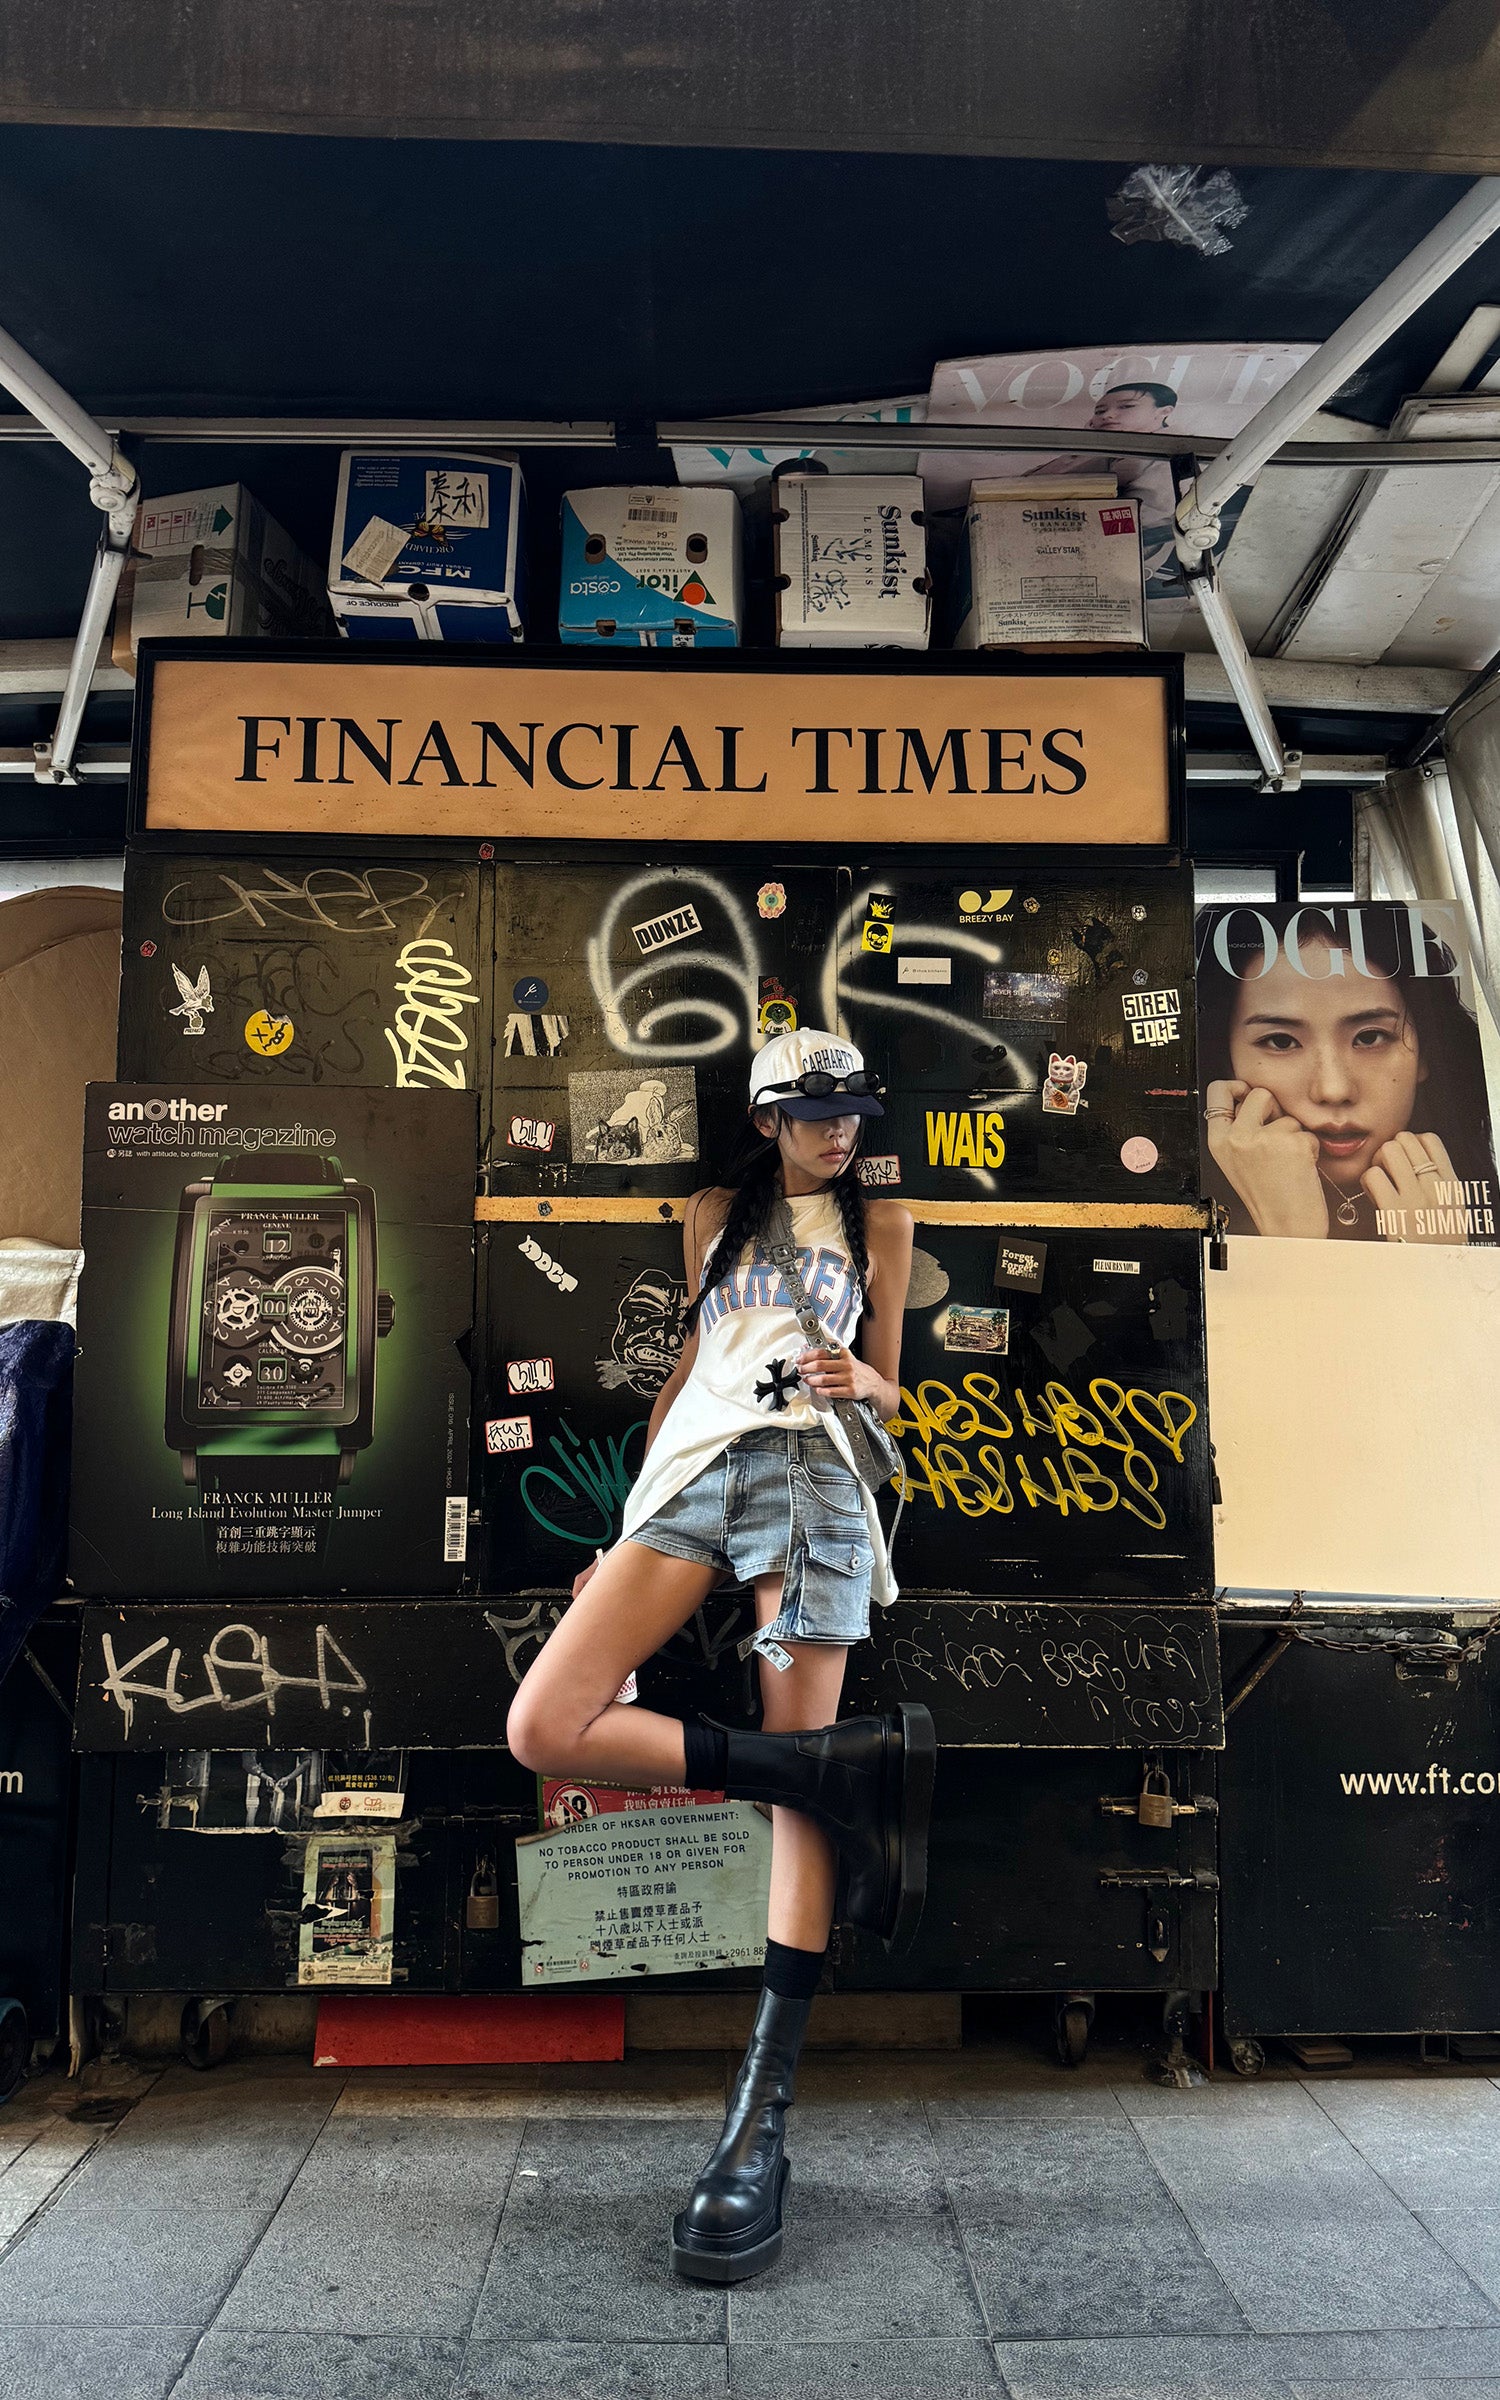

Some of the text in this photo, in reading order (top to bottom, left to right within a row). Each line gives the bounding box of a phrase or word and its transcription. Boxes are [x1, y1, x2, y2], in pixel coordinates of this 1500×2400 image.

[1022, 507, 1088, 524] Sunkist
[1102, 508, 1132, 521] 星期四
[864, 516, 873, 586] LEMONS
[877, 505, 907, 599] Sunkist
[398, 565, 470, 579] MFC
[569, 581, 621, 596] costa
[235, 716, 1088, 796] FINANCIAL TIMES
[635, 907, 698, 951] DUNZE
[959, 913, 1014, 924] BREEZY BAY
[1196, 906, 1463, 981] OGUE
[1123, 991, 1179, 1018] SIREN
[1131, 1018, 1180, 1046] EDGE
[108, 1098, 228, 1122] another
[108, 1122, 337, 1151] watch magazine
[925, 1111, 1006, 1168] WAIS
[1434, 1181, 1492, 1205] WHITE
[241, 1213, 320, 1221] FRANCK MULLER
[1375, 1209, 1495, 1235] HOT SUMMER
[268, 1239, 288, 1252] 12
[1002, 1249, 1035, 1263] Forget
[1002, 1260, 1034, 1273] Forget
[1021, 1271, 1038, 1280] Not
[264, 1300, 286, 1313] 00
[263, 1366, 283, 1381] 30
[203, 1492, 333, 1504] FRANCK MULLER
[152, 1506, 384, 1521] Long Island Evolution Master Jumper
[215, 1541, 317, 1553] 複雜功能技術突破
[1340, 1763, 1500, 1795] www.ft.co
[563, 1811, 739, 1835] ORDER OF HKSAR GOVERNMENT:
[539, 1830, 750, 1857] NO TOBACCO PRODUCT SHALL BE SOLD
[545, 1844, 746, 1870] TO PERSON UNDER 18 OR GIVEN FOR
[568, 1858, 725, 1881] PROMOTION TO ANY PERSON
[594, 1901, 703, 1923] 禁止售賣煙草產品予
[595, 1916, 704, 1938] 十八歲以下人士或派
